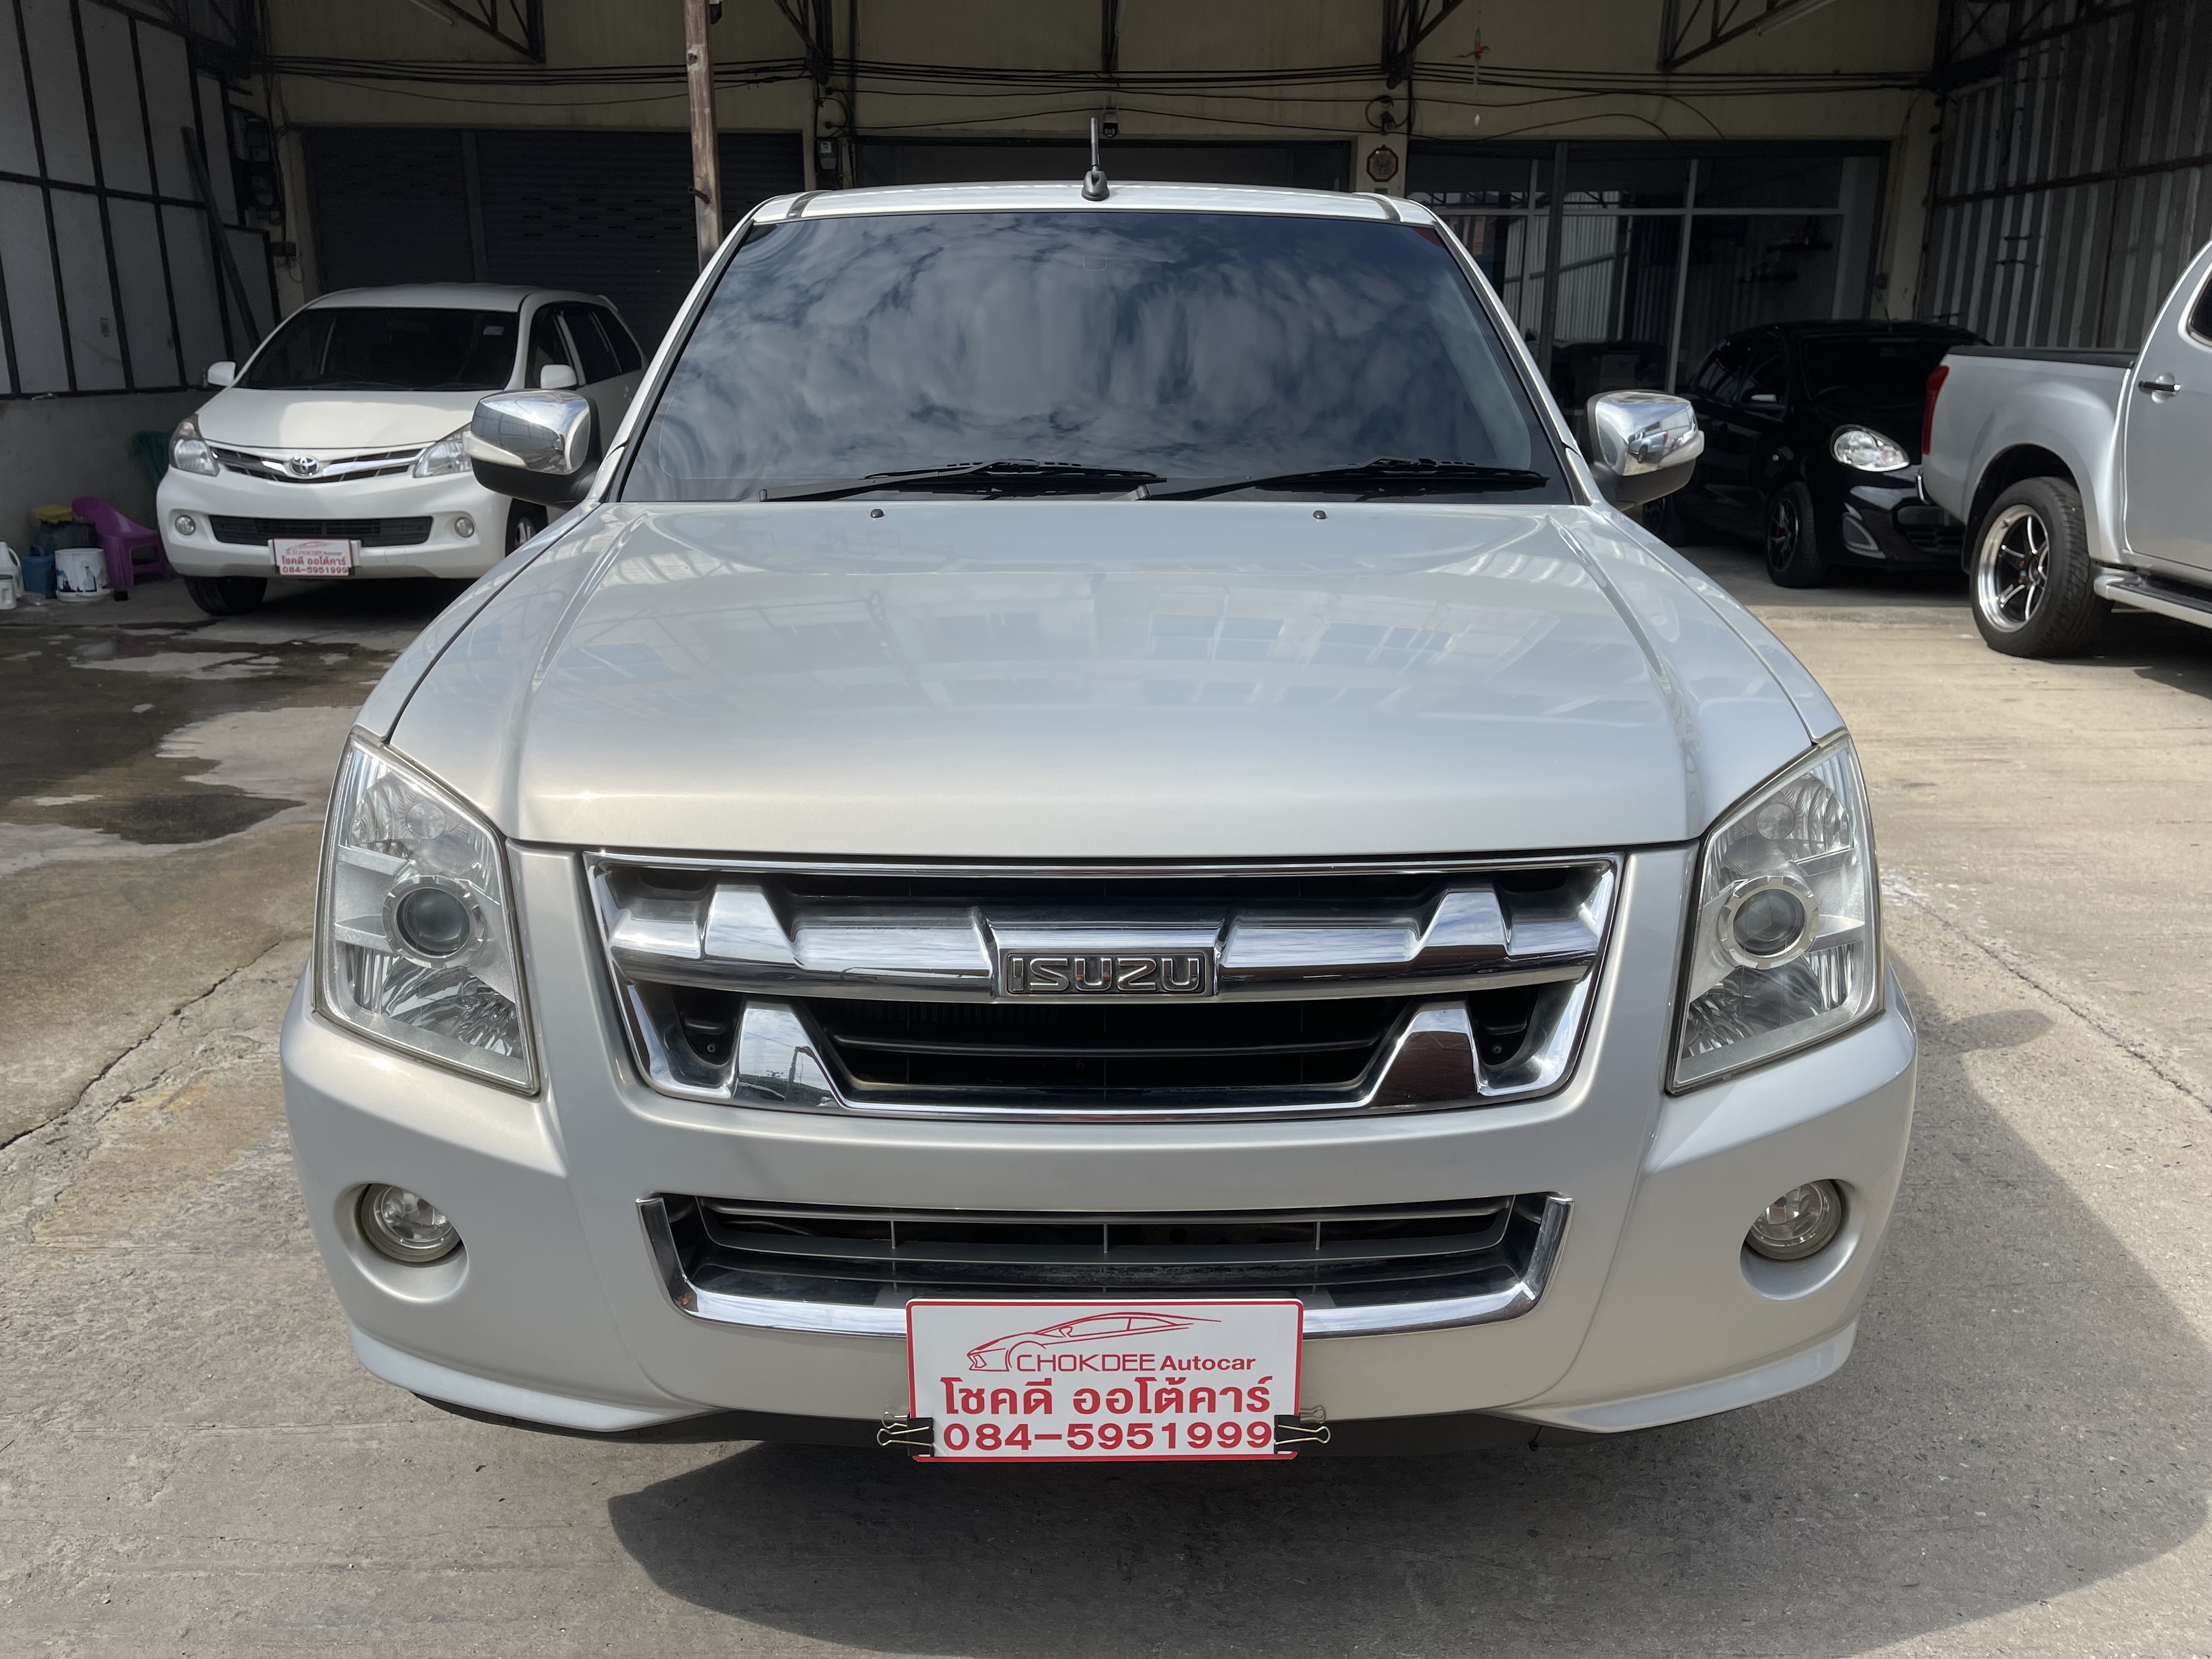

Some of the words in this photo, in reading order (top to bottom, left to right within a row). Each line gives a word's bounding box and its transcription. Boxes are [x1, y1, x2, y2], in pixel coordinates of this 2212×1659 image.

[1012, 957, 1200, 991] ISUZU
[1017, 1353, 1156, 1373] CHOKDEE
[1160, 1355, 1256, 1372] Autocar
[940, 1376, 1053, 1415] โชคดี
[1073, 1375, 1273, 1415] ออโต้คาร์
[943, 1421, 1273, 1451] 084-5951999
